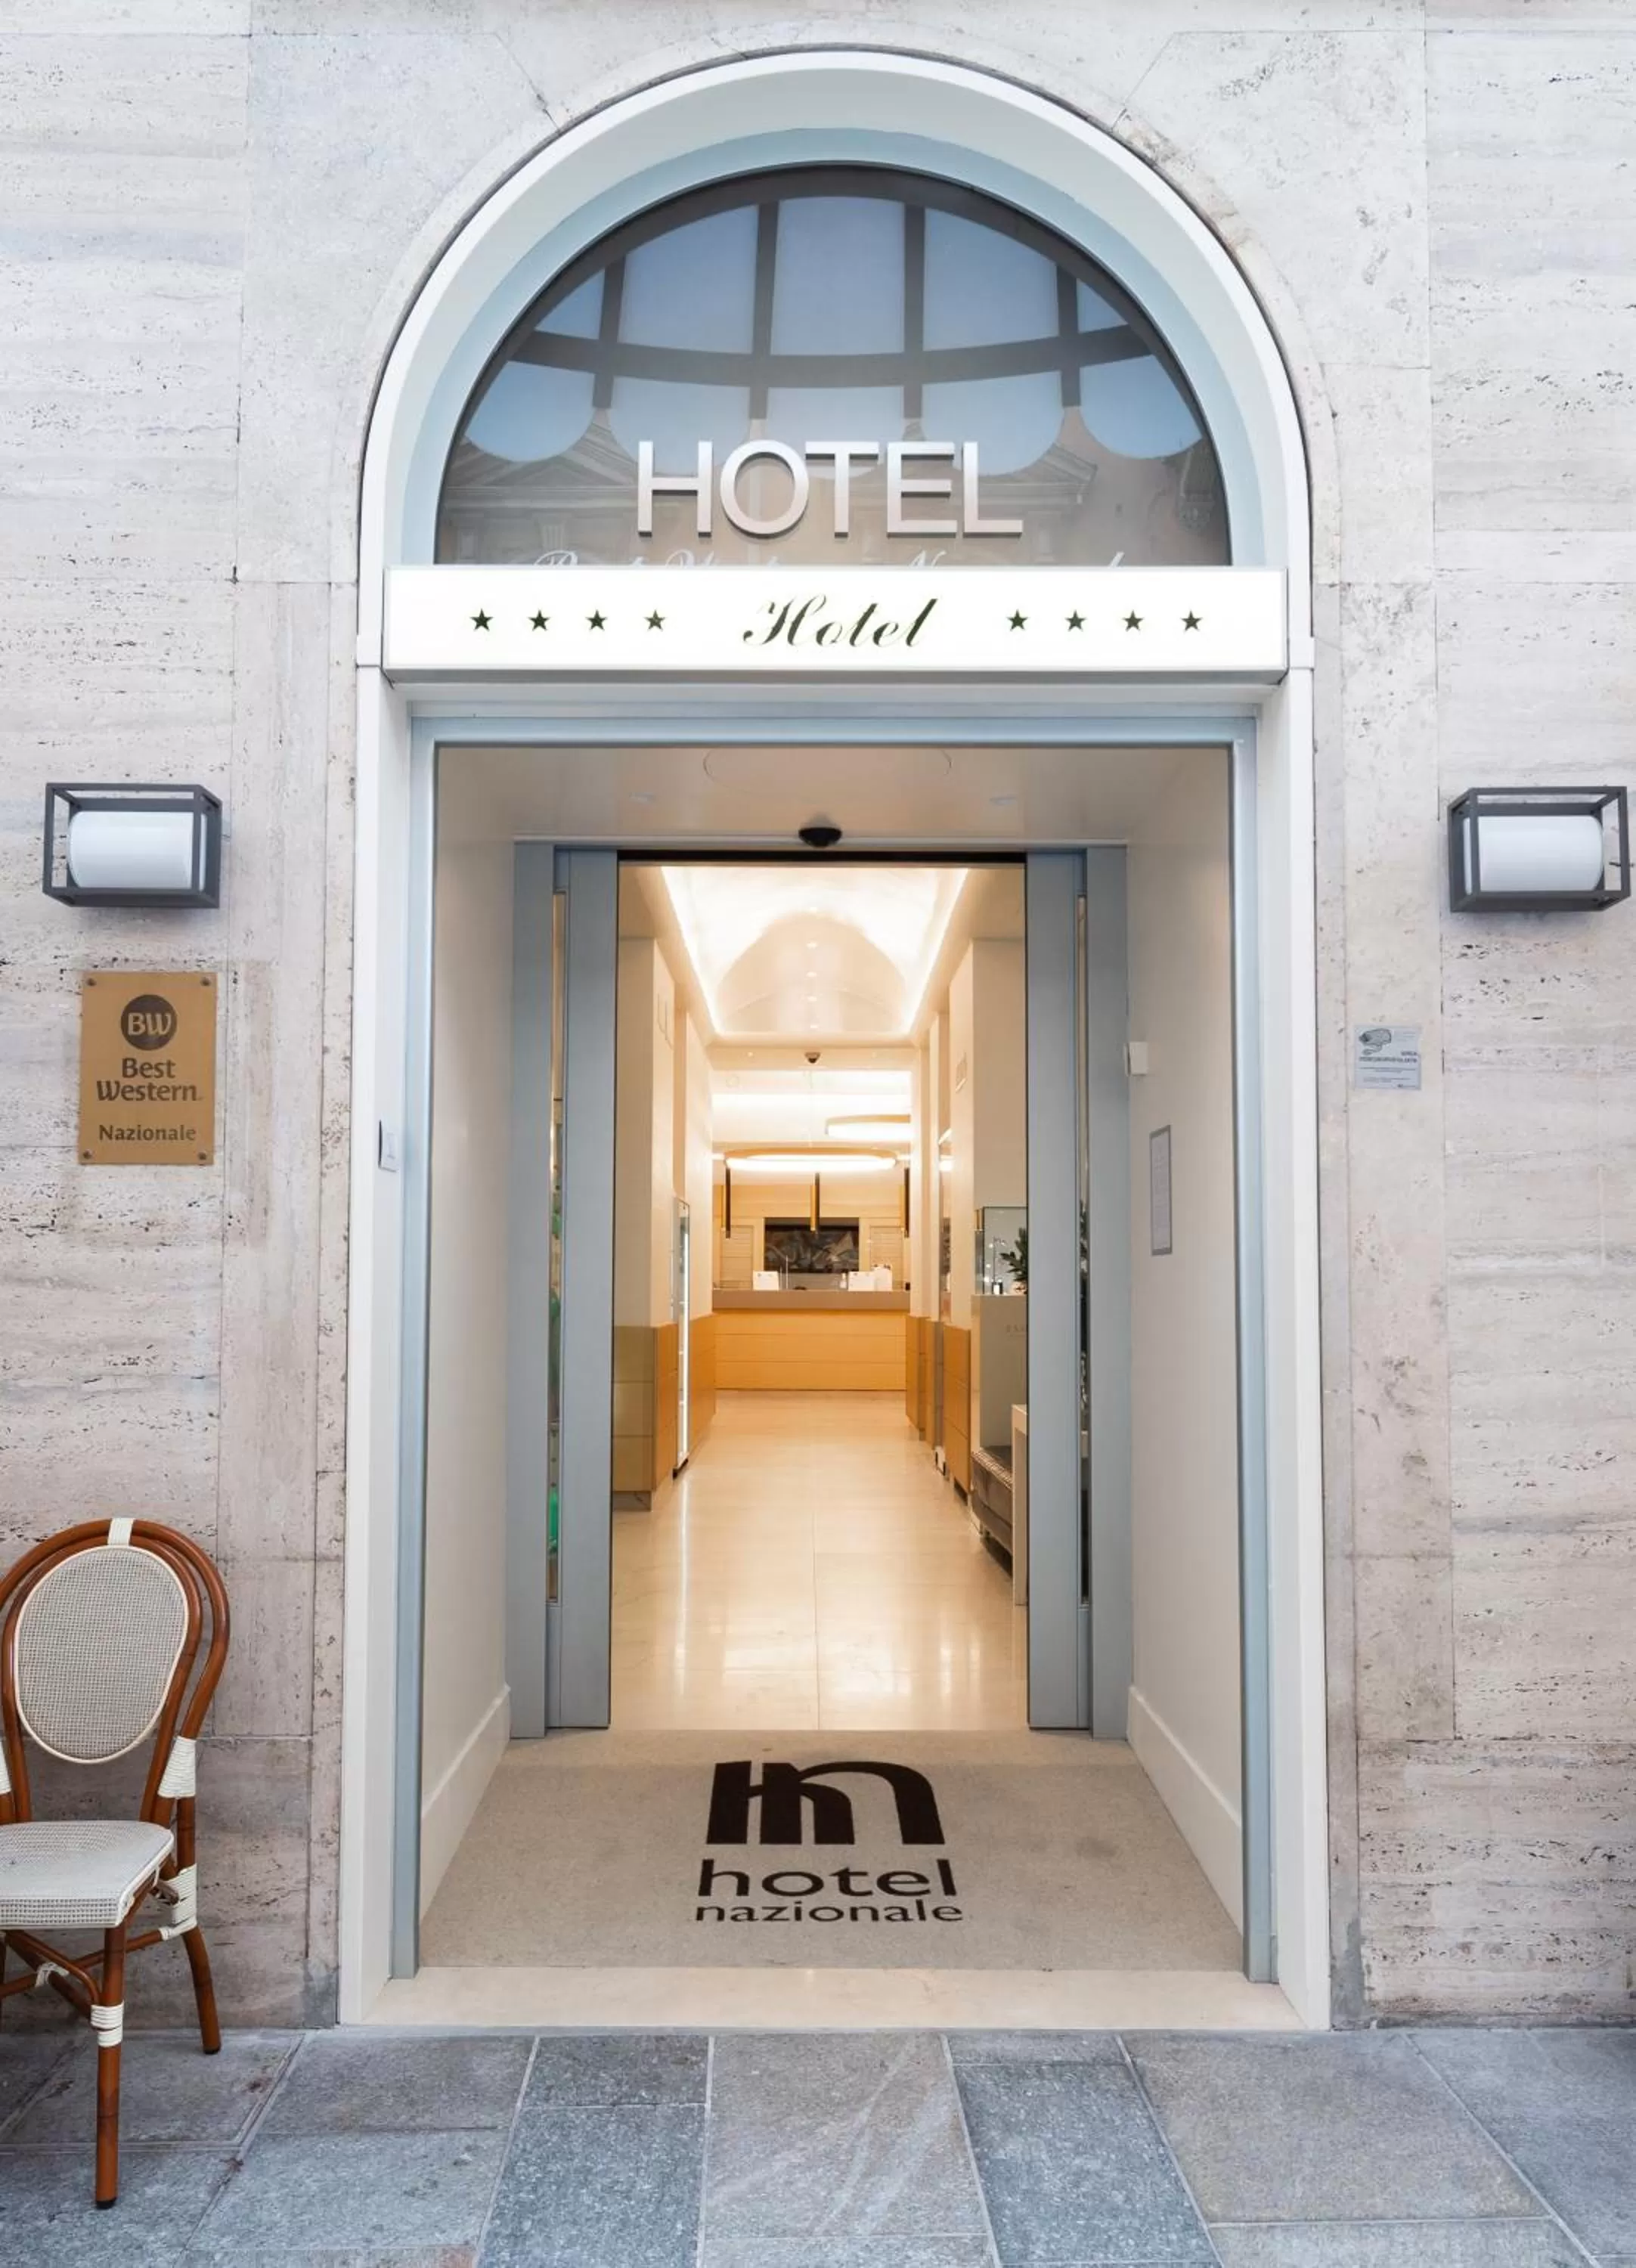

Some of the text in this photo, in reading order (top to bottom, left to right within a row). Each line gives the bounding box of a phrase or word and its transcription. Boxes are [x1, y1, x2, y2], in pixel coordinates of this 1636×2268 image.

[638, 439, 1024, 538] HOTEL
[742, 593, 938, 648] Hotel
[127, 1012, 172, 1036] BW
[122, 1057, 177, 1079] Best
[97, 1080, 197, 1101] Western
[99, 1124, 196, 1141] Nazionale
[698, 1858, 957, 1897] hotel
[696, 1899, 963, 1923] nazionale
